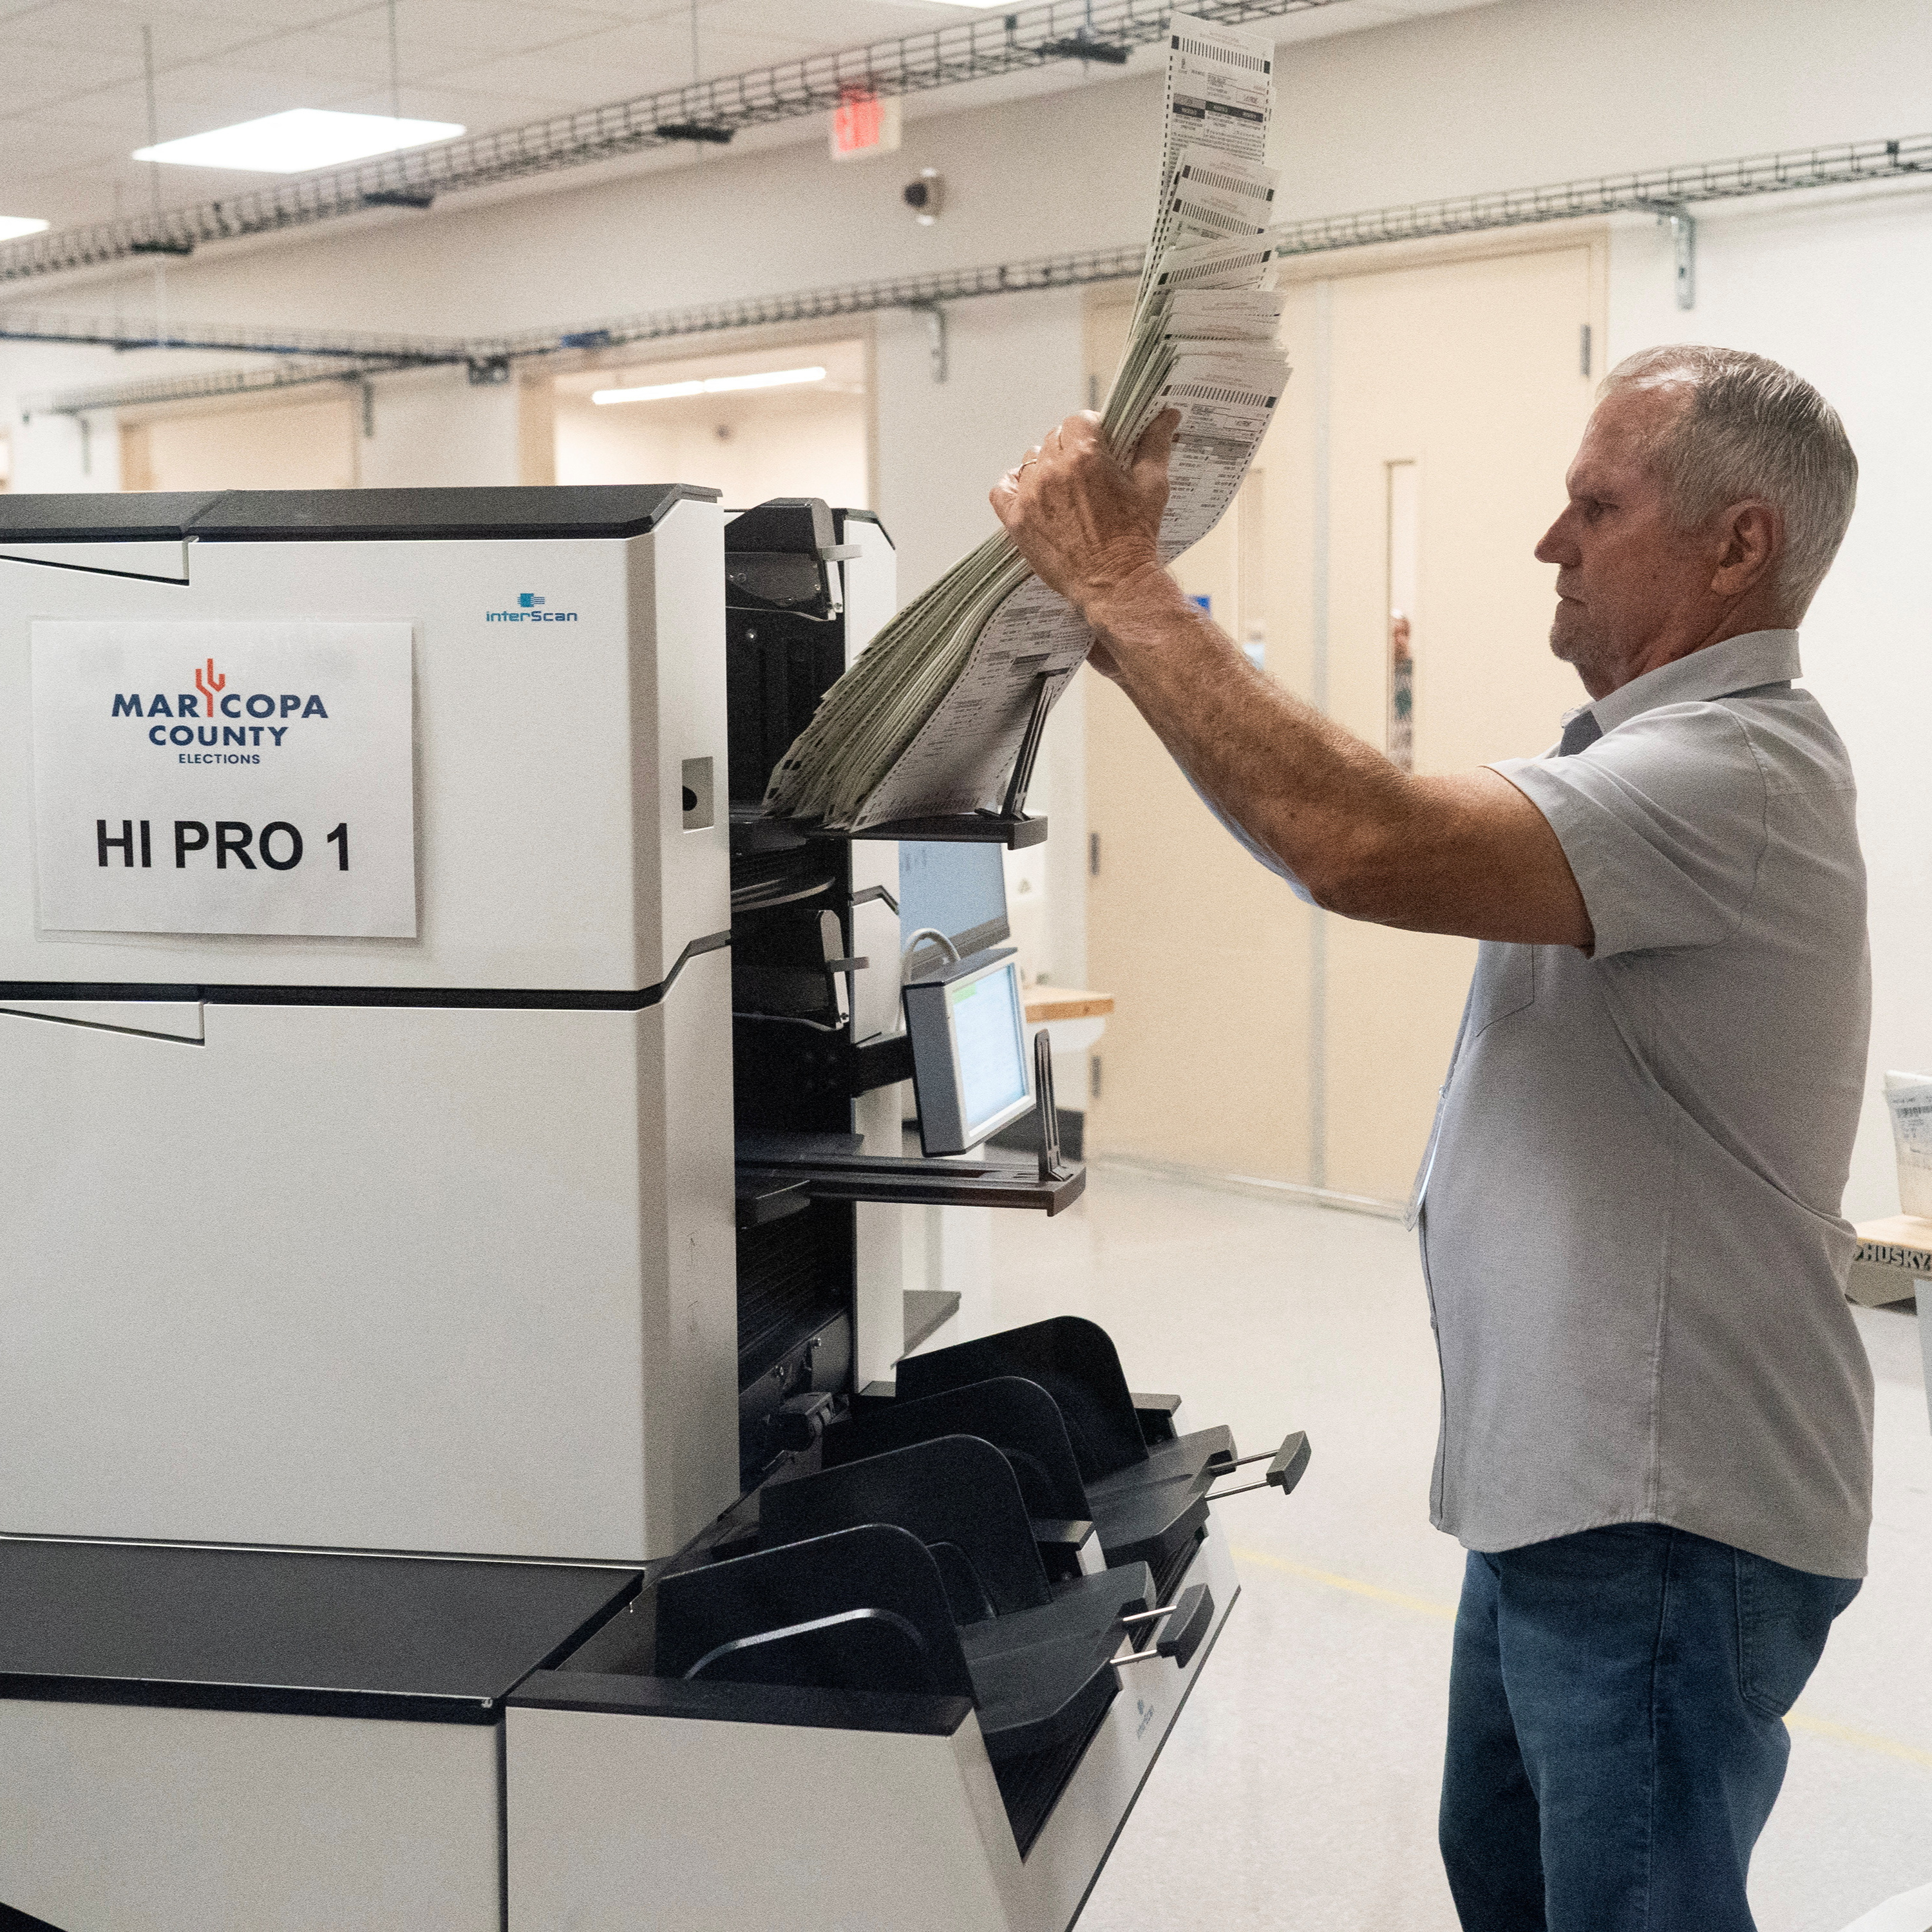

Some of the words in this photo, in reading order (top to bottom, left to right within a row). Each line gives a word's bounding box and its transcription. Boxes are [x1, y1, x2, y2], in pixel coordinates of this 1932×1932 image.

[486, 611, 578, 621] interScan
[149, 725, 289, 746] COUNTY
[178, 753, 261, 764] ELECTIONS
[97, 819, 152, 869] HI
[174, 820, 304, 871] PRO
[327, 822, 349, 872] 1
